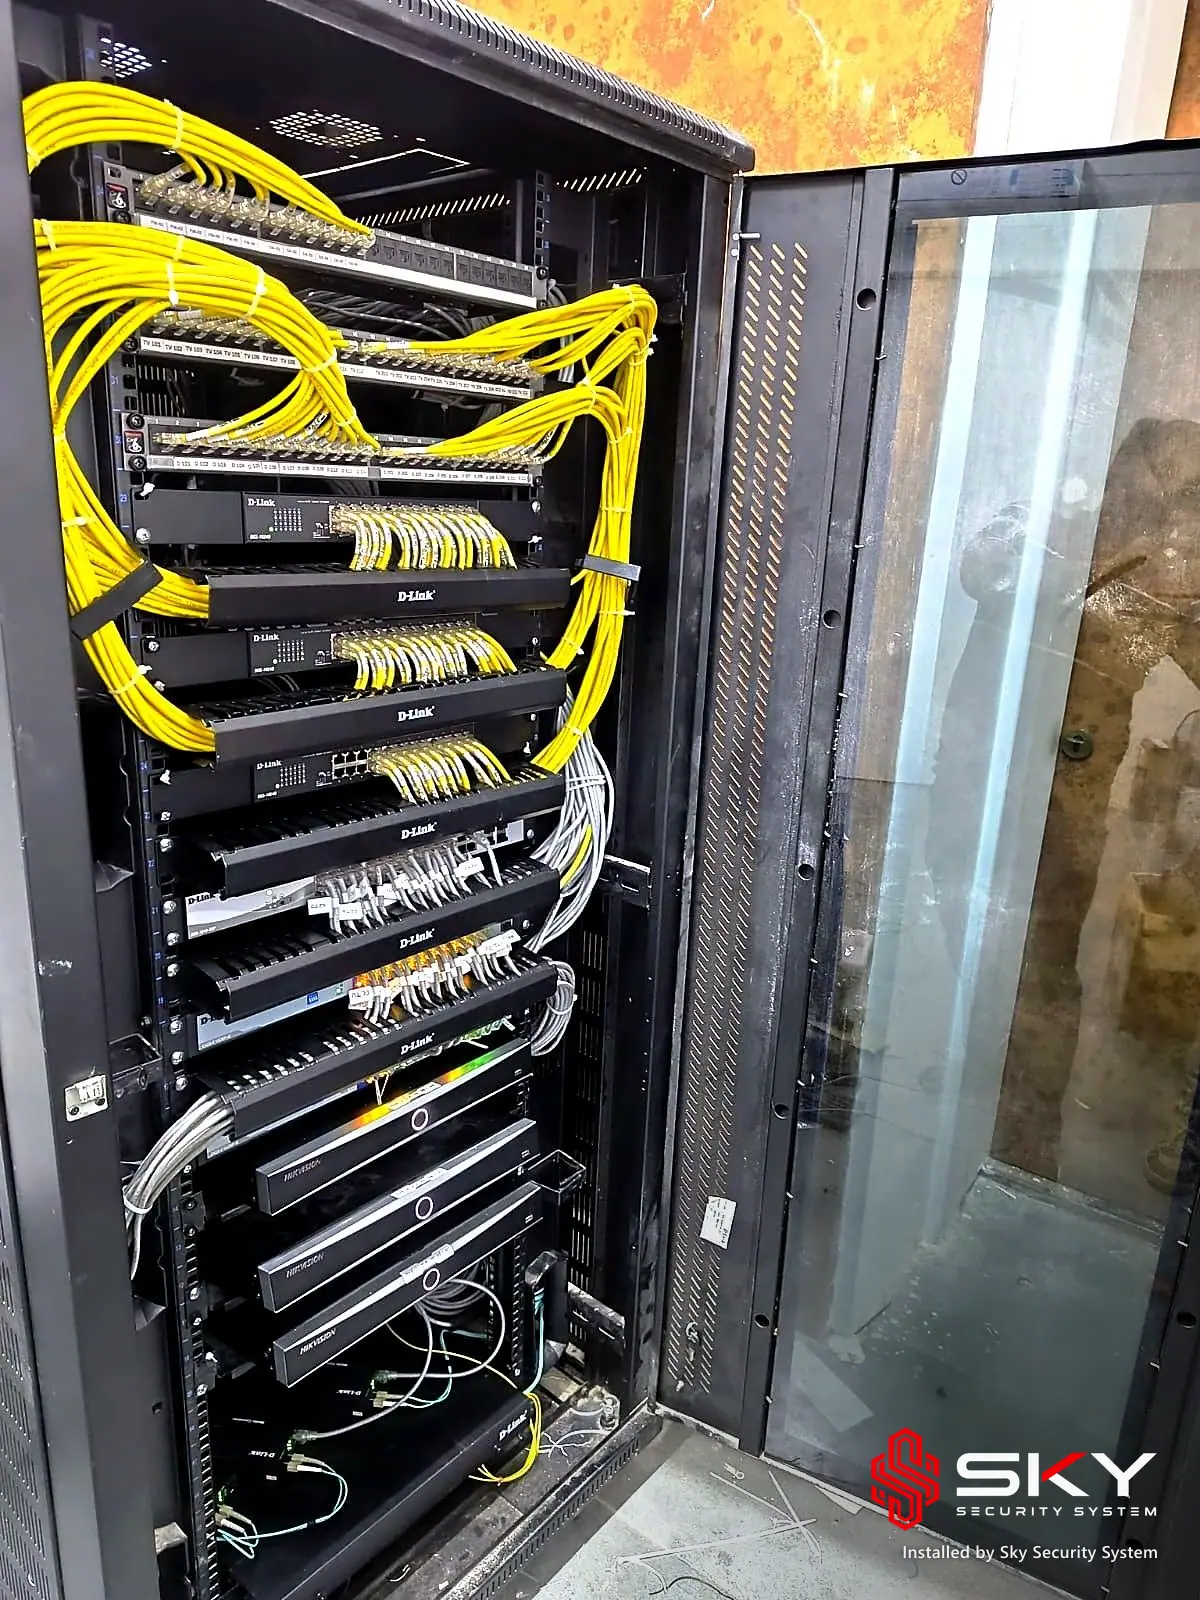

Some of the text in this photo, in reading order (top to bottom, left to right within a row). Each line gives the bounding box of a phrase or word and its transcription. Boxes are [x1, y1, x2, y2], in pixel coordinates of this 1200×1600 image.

[248, 498, 276, 506] D-Link
[398, 590, 434, 602] D-Link
[254, 634, 279, 642] D-Link
[398, 706, 434, 722] D-Link
[256, 760, 282, 770] D-Link
[401, 823, 436, 840] D-Link
[400, 930, 434, 949] D-Link
[400, 1034, 433, 1055] D-Link
[500, 1412, 527, 1440] D-Link
